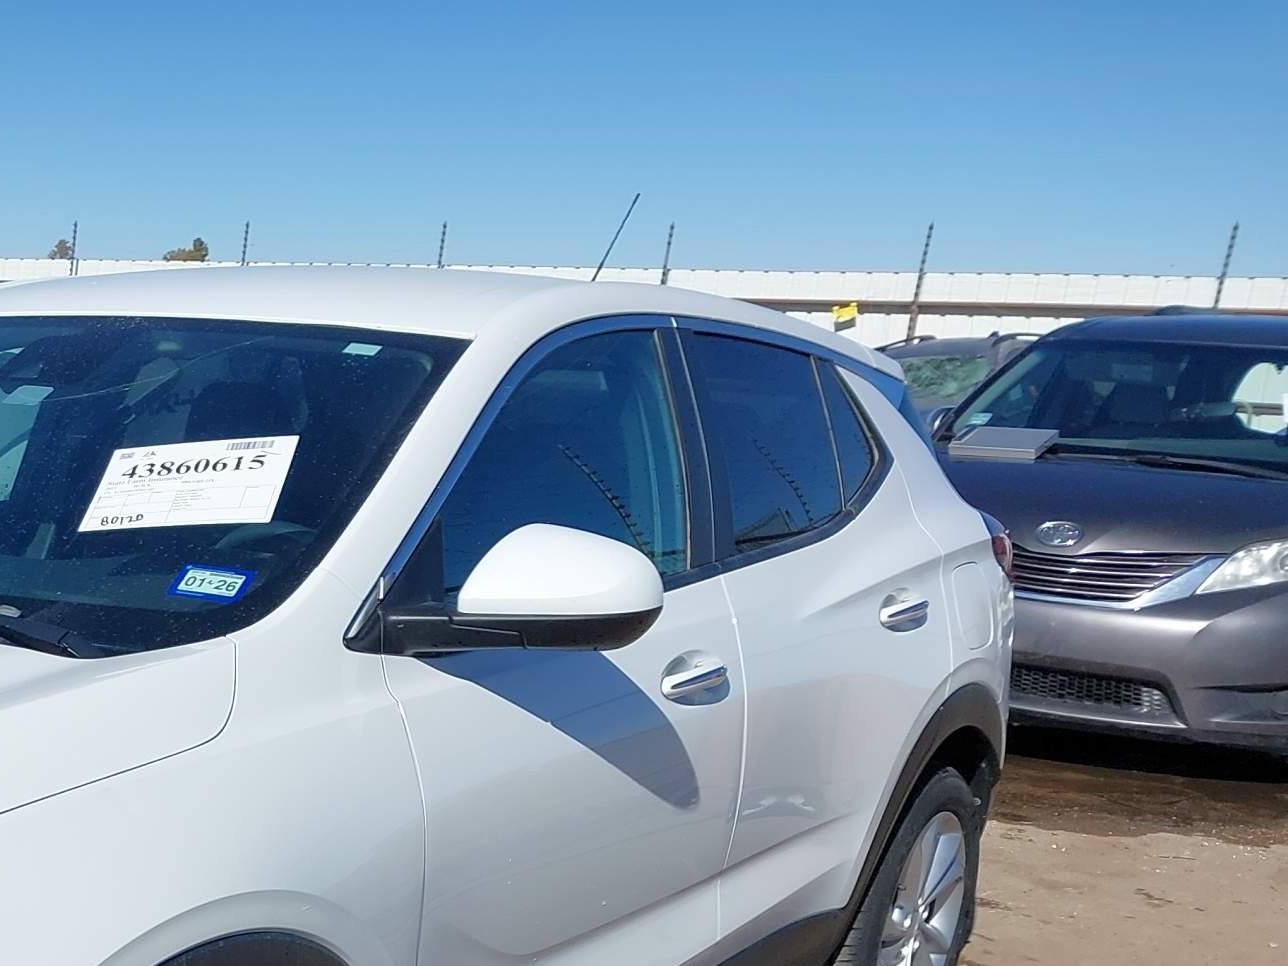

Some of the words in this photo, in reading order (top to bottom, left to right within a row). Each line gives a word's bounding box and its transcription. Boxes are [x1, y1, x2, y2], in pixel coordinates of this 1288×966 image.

[121, 454, 268, 479] 43860615
[184, 576, 206, 588] 01
[214, 579, 238, 592] 26
